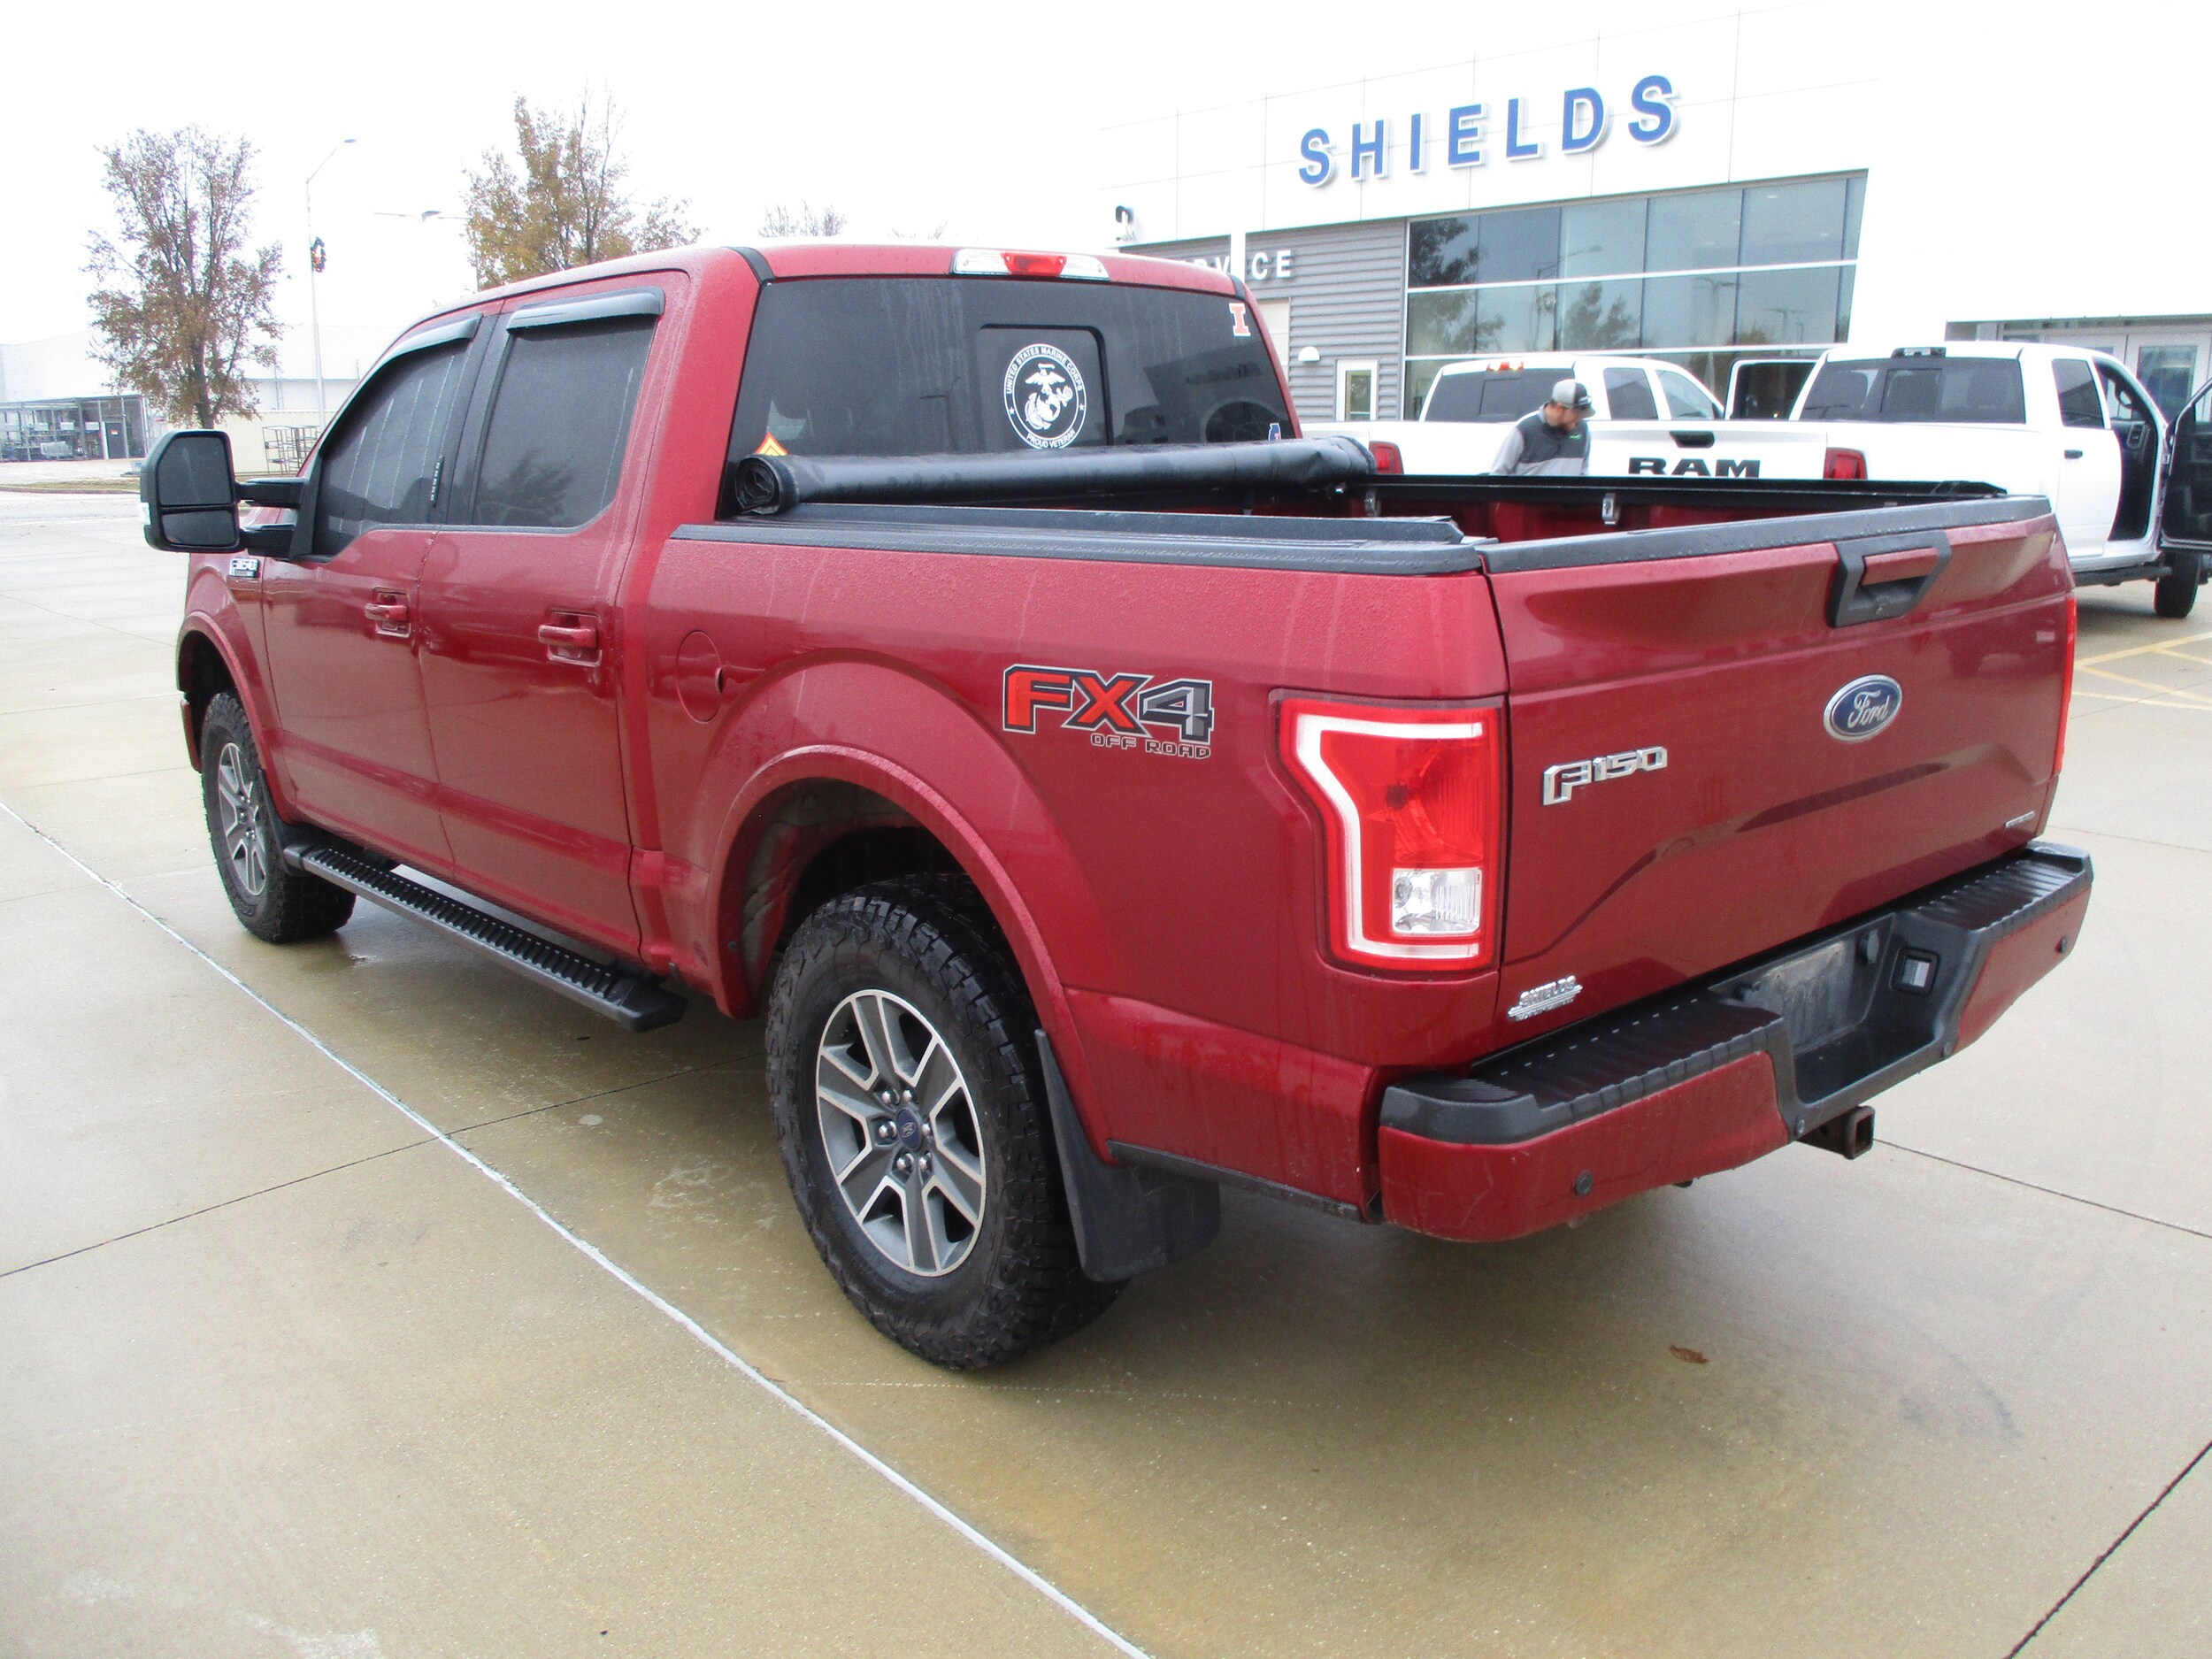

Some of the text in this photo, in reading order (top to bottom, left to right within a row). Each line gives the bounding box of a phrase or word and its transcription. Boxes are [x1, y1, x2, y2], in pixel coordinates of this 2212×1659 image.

[1298, 74, 1676, 187] SHIELDS
[1006, 346, 1084, 395] UNITED STATES MARINE CORPS
[1025, 427, 1076, 449] PROUD VETERAN
[1628, 449, 1761, 479] RAM
[1002, 664, 1215, 746] FX4
[1847, 689, 1891, 729] Ford
[1090, 733, 1211, 760] OFF ROAD
[1541, 745, 1668, 806] F150
